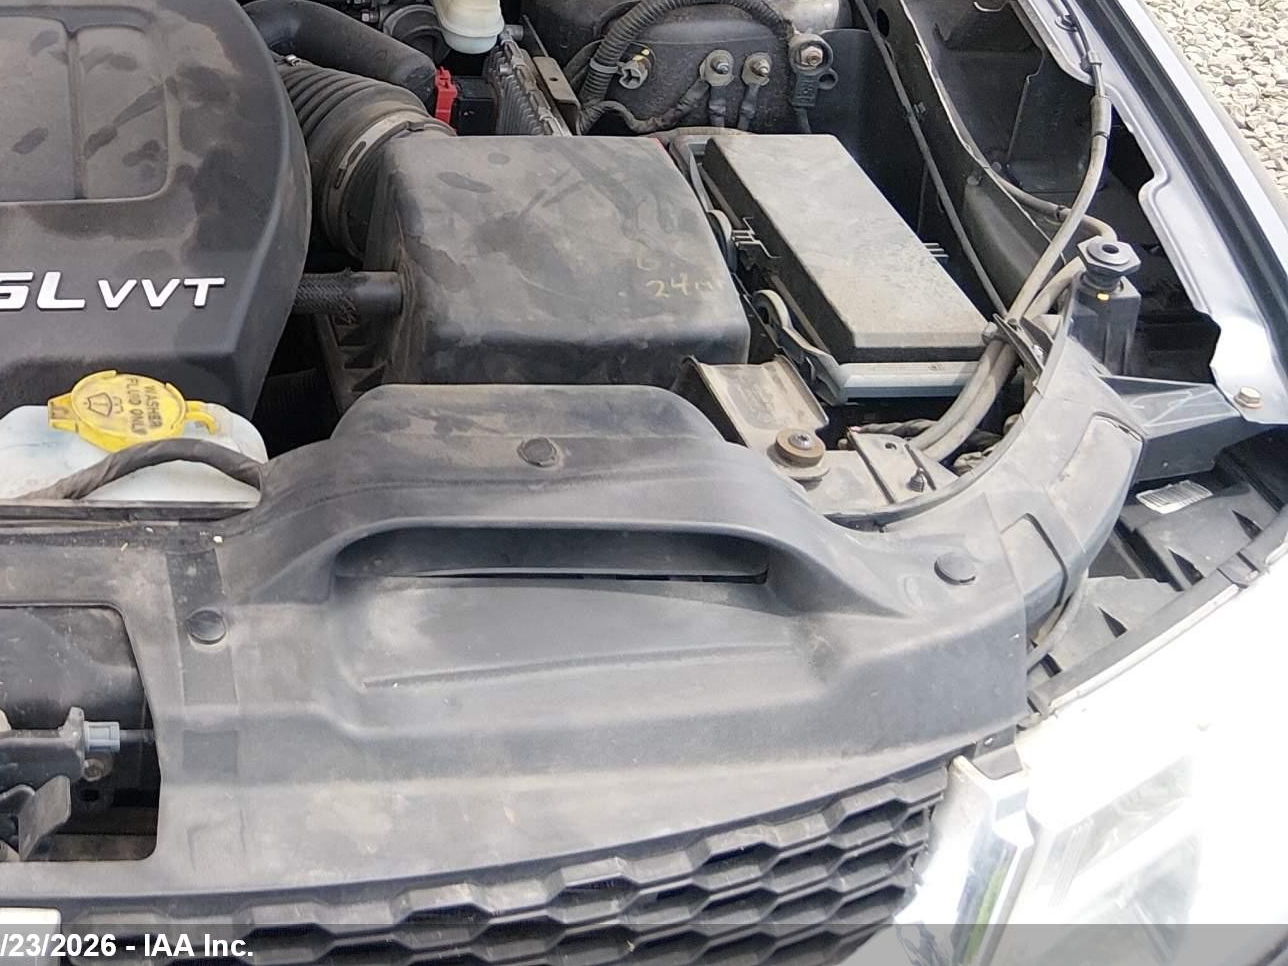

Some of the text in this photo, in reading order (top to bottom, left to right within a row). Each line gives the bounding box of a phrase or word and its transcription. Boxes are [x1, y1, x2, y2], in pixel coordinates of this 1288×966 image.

[98, 277, 225, 308] VVT
[131, 409, 147, 435] ONLY
[144, 386, 162, 428] WASHER
